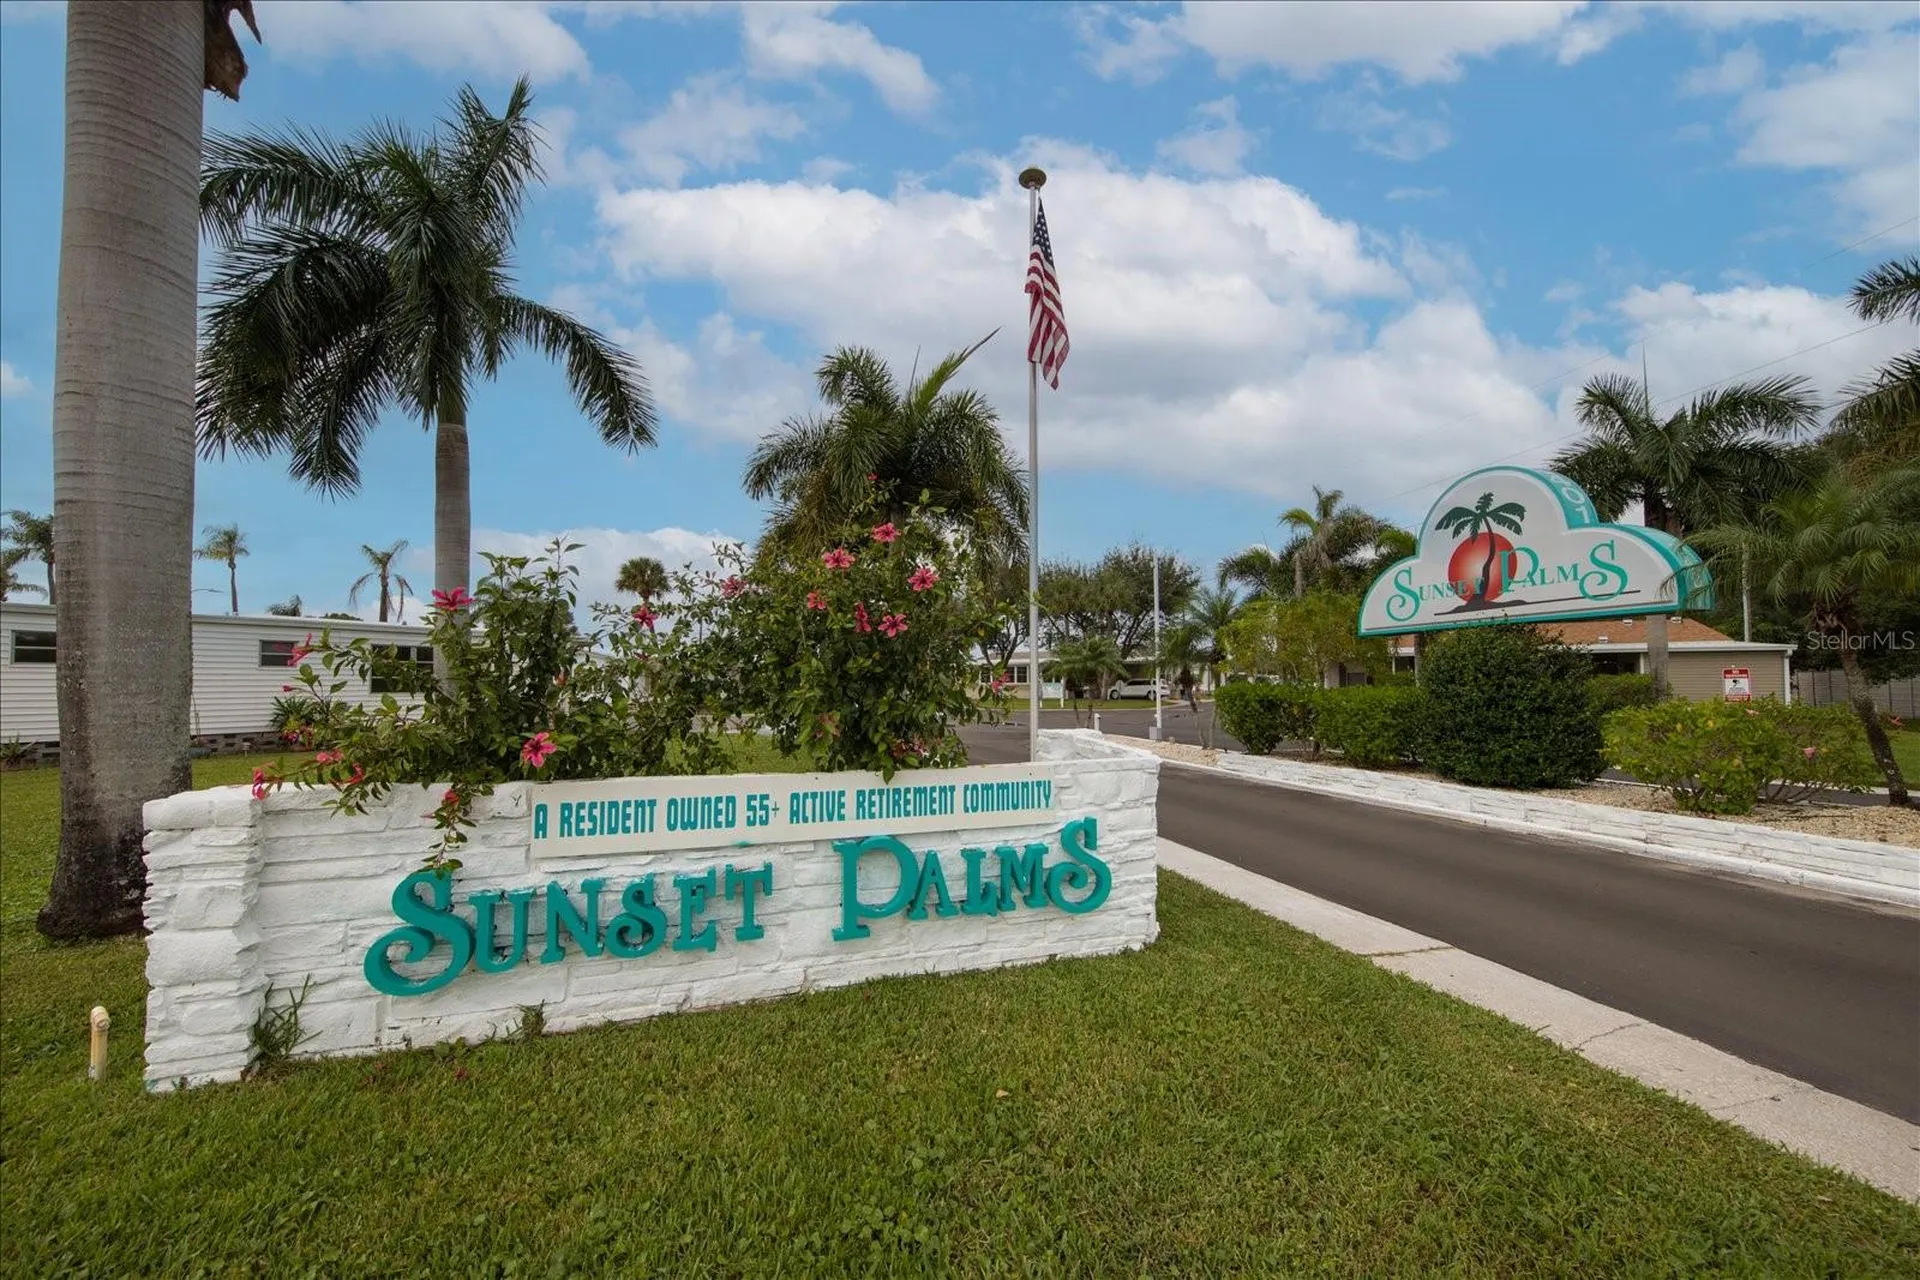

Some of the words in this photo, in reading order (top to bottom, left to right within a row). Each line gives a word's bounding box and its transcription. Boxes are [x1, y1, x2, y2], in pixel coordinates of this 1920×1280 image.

[1499, 539, 1628, 601] PALMS
[534, 803, 548, 839] A
[559, 799, 657, 838] RESIDENT
[666, 795, 736, 830] OWNED
[746, 794, 781, 826] 55+
[789, 790, 846, 824] ACTIVE
[856, 785, 956, 820] RETIREMENT
[963, 780, 1052, 814] COMMUNITY
[364, 862, 773, 996] SUNSET
[832, 817, 1113, 942] PALMS
